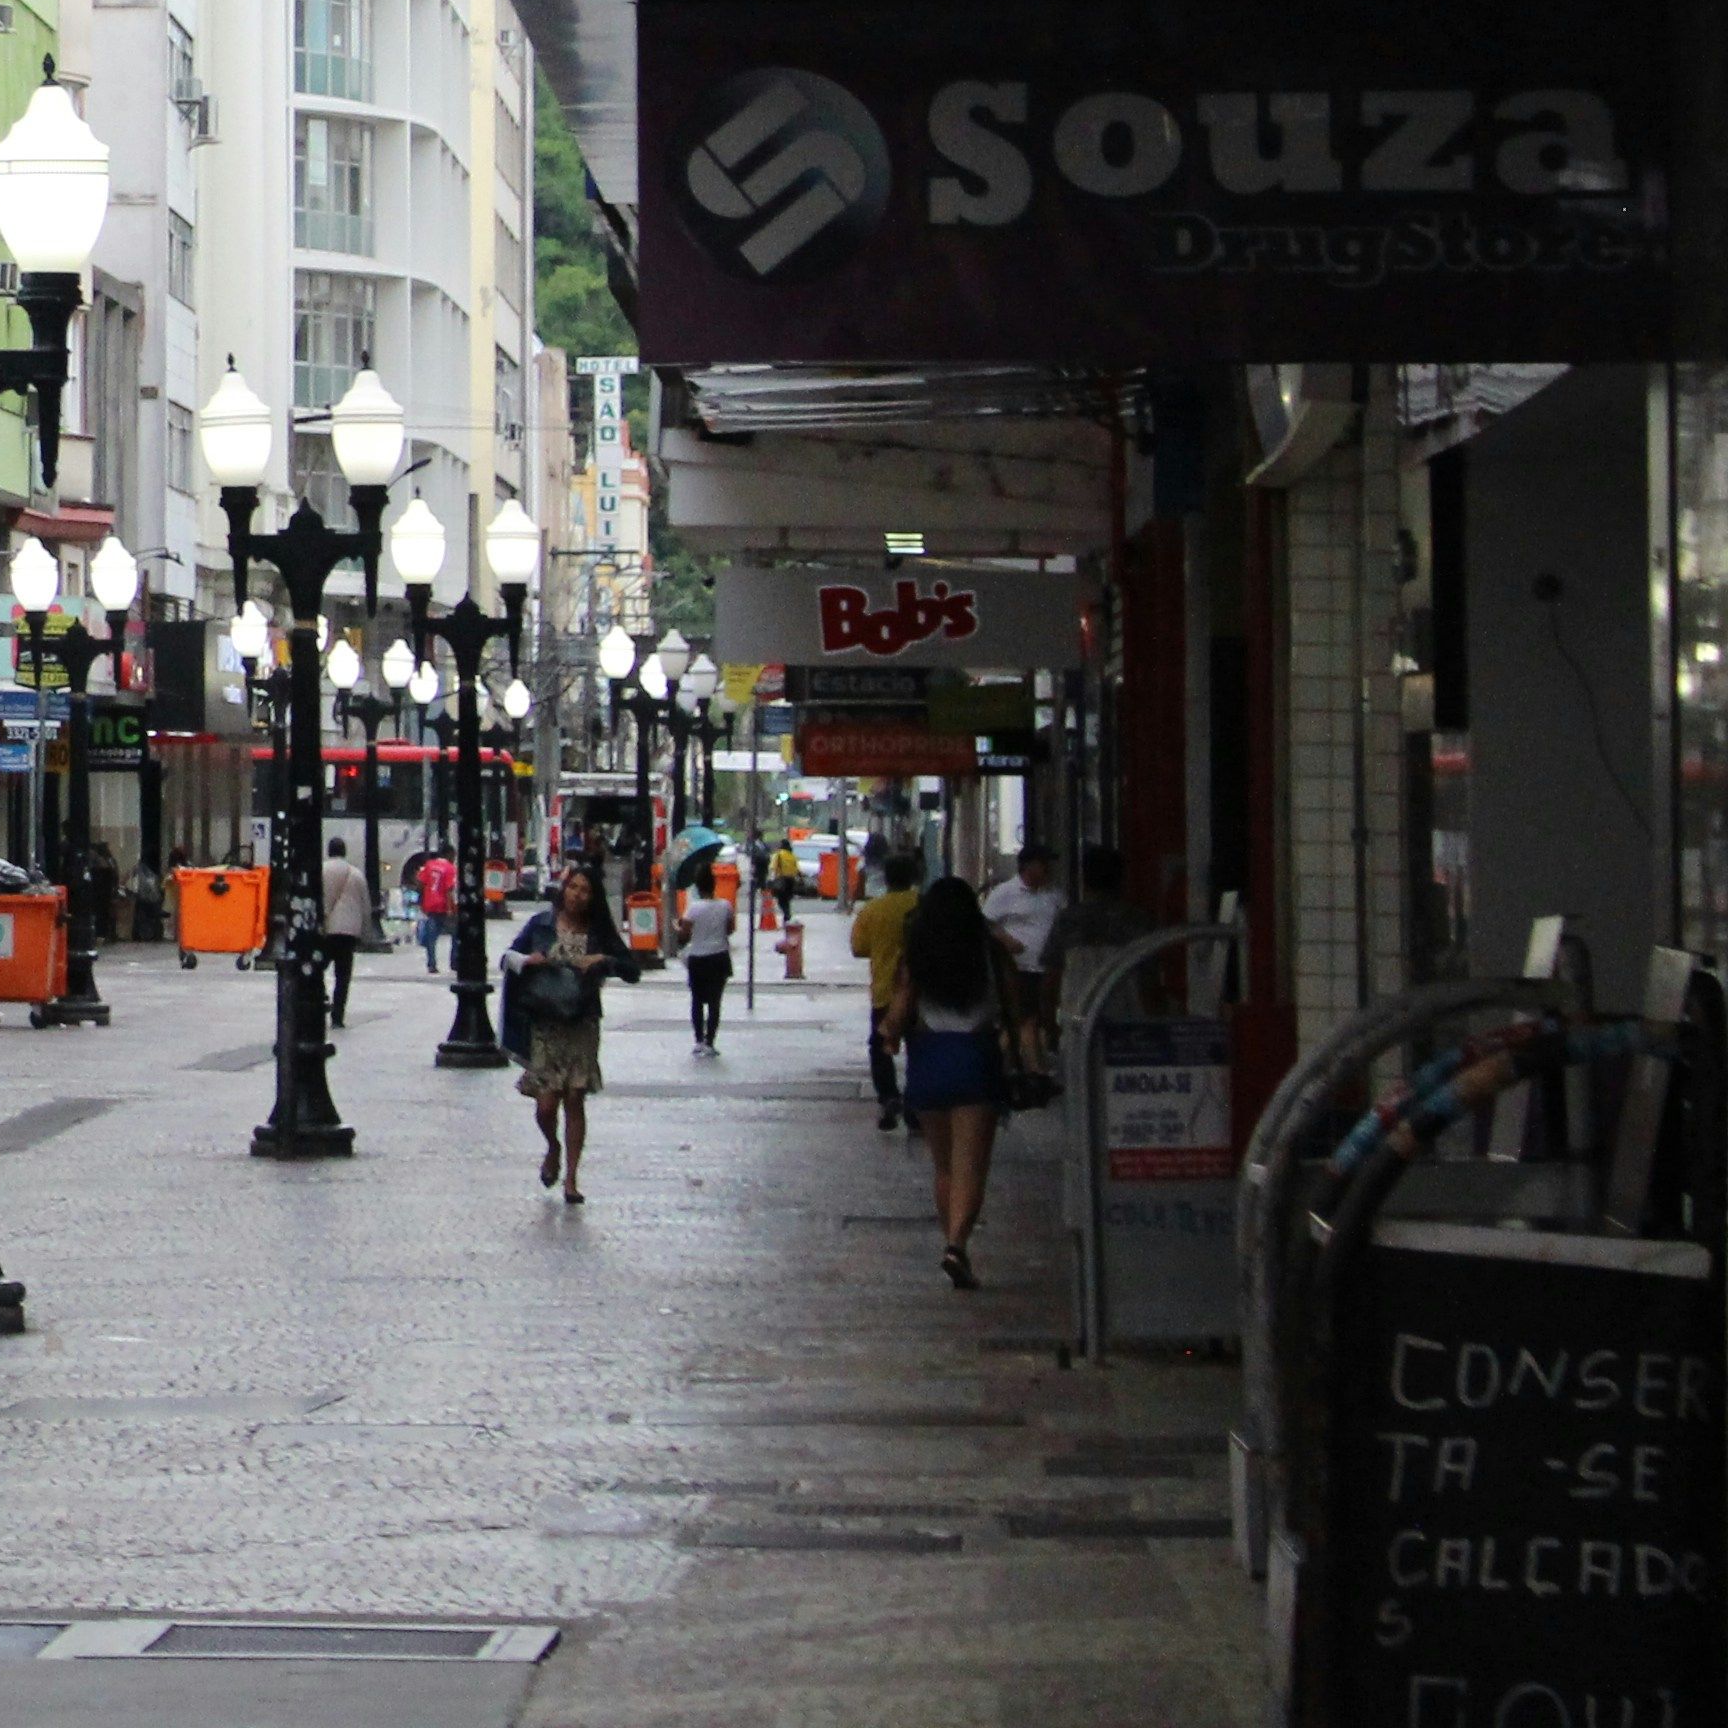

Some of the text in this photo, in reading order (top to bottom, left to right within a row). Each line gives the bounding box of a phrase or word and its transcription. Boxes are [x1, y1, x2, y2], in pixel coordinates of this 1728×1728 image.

[926, 79, 1631, 228] Souza
[578, 357, 636, 372] HOTEL
[819, 580, 978, 655] Bob's
[1389, 1332, 1713, 1422] CONSER
[1374, 1430, 1480, 1505] TA
